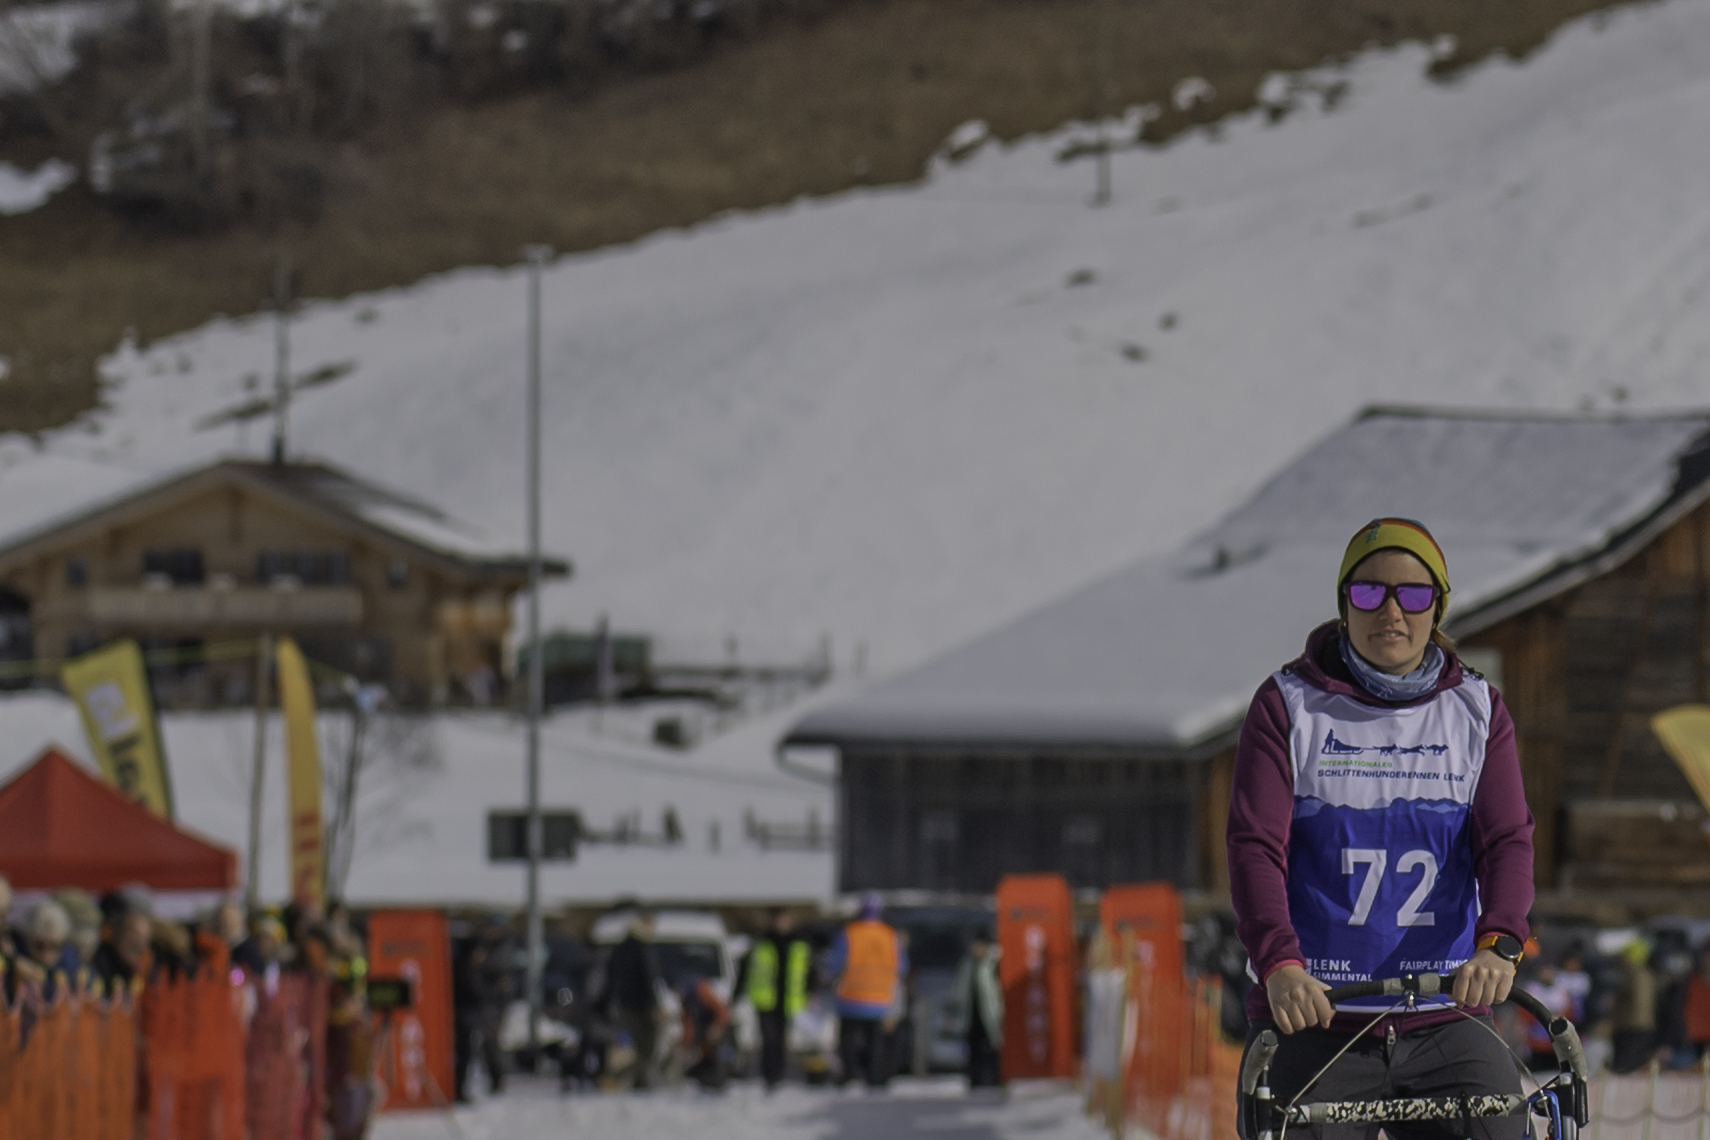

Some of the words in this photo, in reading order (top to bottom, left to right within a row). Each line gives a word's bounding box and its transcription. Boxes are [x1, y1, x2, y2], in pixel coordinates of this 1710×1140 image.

[1319, 759, 1393, 769] INTERNATIONALES
[1317, 769, 1440, 780] SCHLITTENHUNDERENNEN
[1443, 773, 1466, 783] LENK
[1341, 848, 1439, 927] 72
[1313, 958, 1352, 972] LENK
[1399, 959, 1444, 971] FAIRPLAY
[1313, 971, 1373, 983] SIMMENTAL
